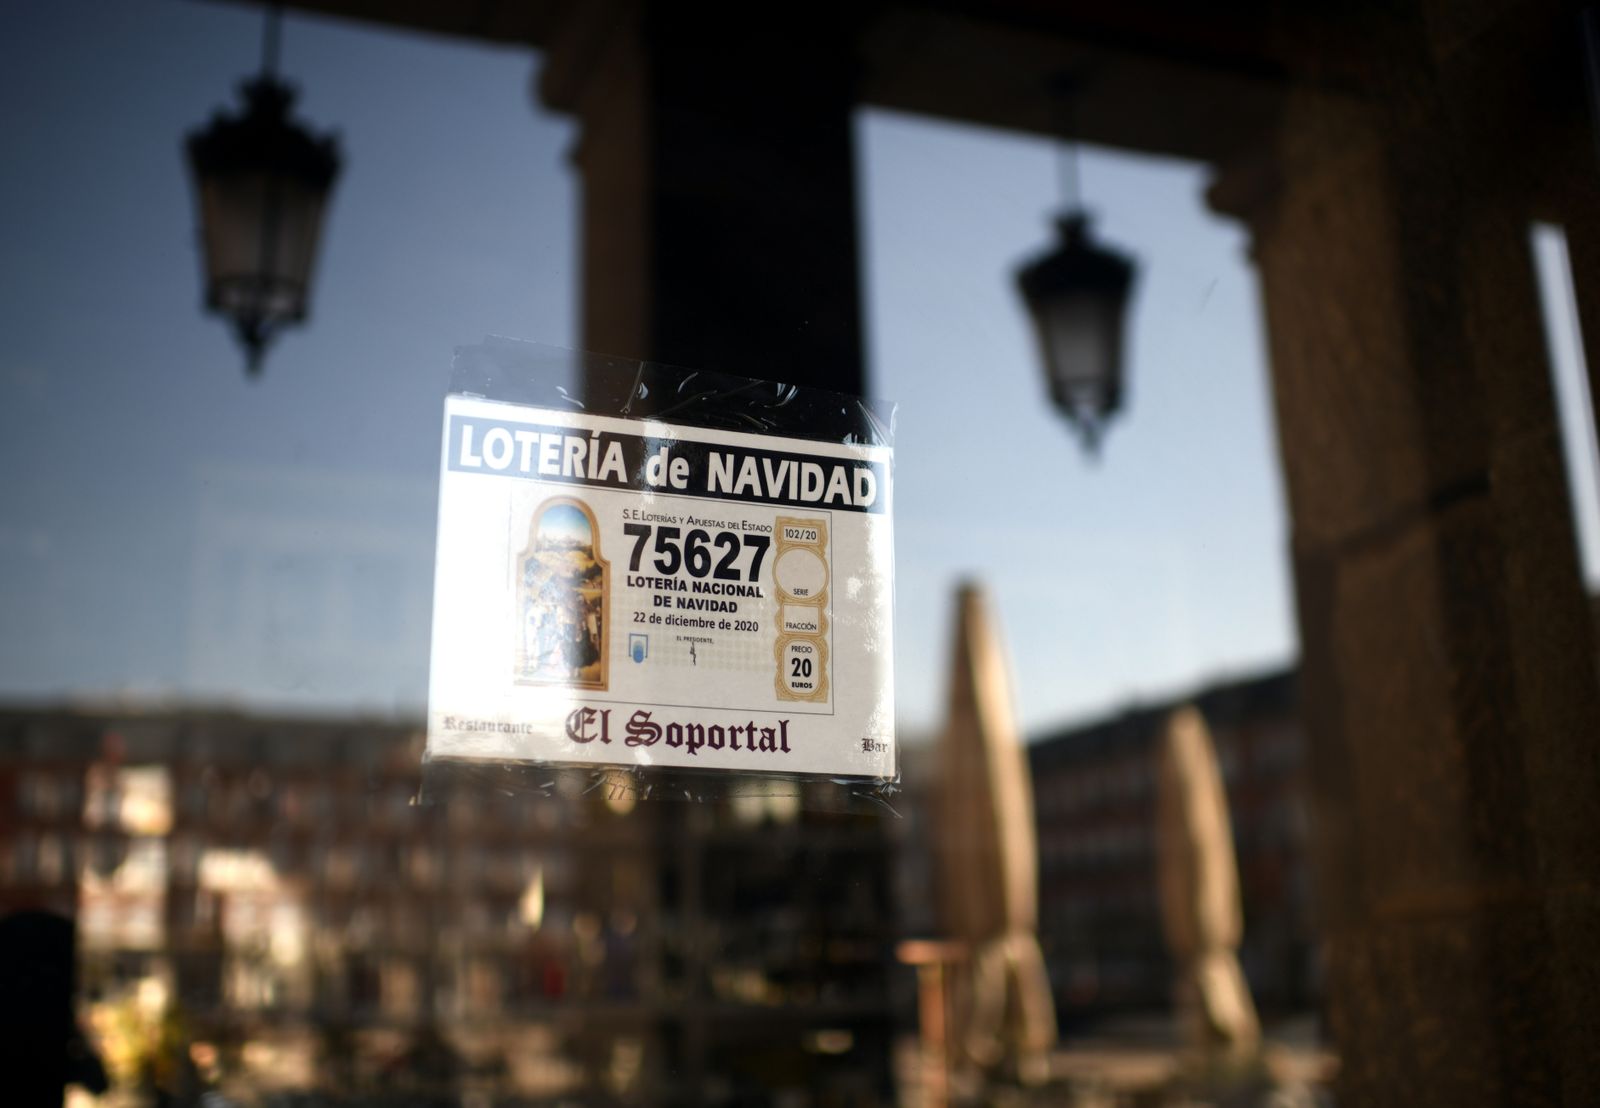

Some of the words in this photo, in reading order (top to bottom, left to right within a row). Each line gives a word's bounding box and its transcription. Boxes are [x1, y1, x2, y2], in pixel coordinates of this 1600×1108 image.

[460, 424, 628, 483] LOTERÍA
[646, 448, 690, 490] de
[708, 452, 877, 507] NAVIDAD
[686, 515, 725, 528] APUESTAS
[728, 521, 740, 530] DEL
[742, 520, 772, 533] ESTADO
[785, 528, 817, 541] 102/20
[623, 522, 770, 583] 75627
[627, 575, 687, 592] LOTERÍA
[692, 581, 763, 598] NACIONAL
[793, 588, 808, 596] SERIE
[653, 594, 672, 608] DE
[676, 597, 738, 613] NAVIDAD
[633, 612, 646, 623] 22
[649, 612, 662, 625] de
[665, 614, 716, 629] diciembre
[718, 618, 731, 630] de
[734, 620, 759, 632] 2020
[785, 621, 817, 630] FRACCIÓN
[791, 645, 813, 653] PRECIO
[791, 657, 812, 678] 20
[791, 681, 813, 689] EUROS
[443, 715, 534, 735] Restaurante
[565, 706, 612, 744] El
[623, 710, 791, 756] Soportal
[861, 737, 888, 753] Bar
